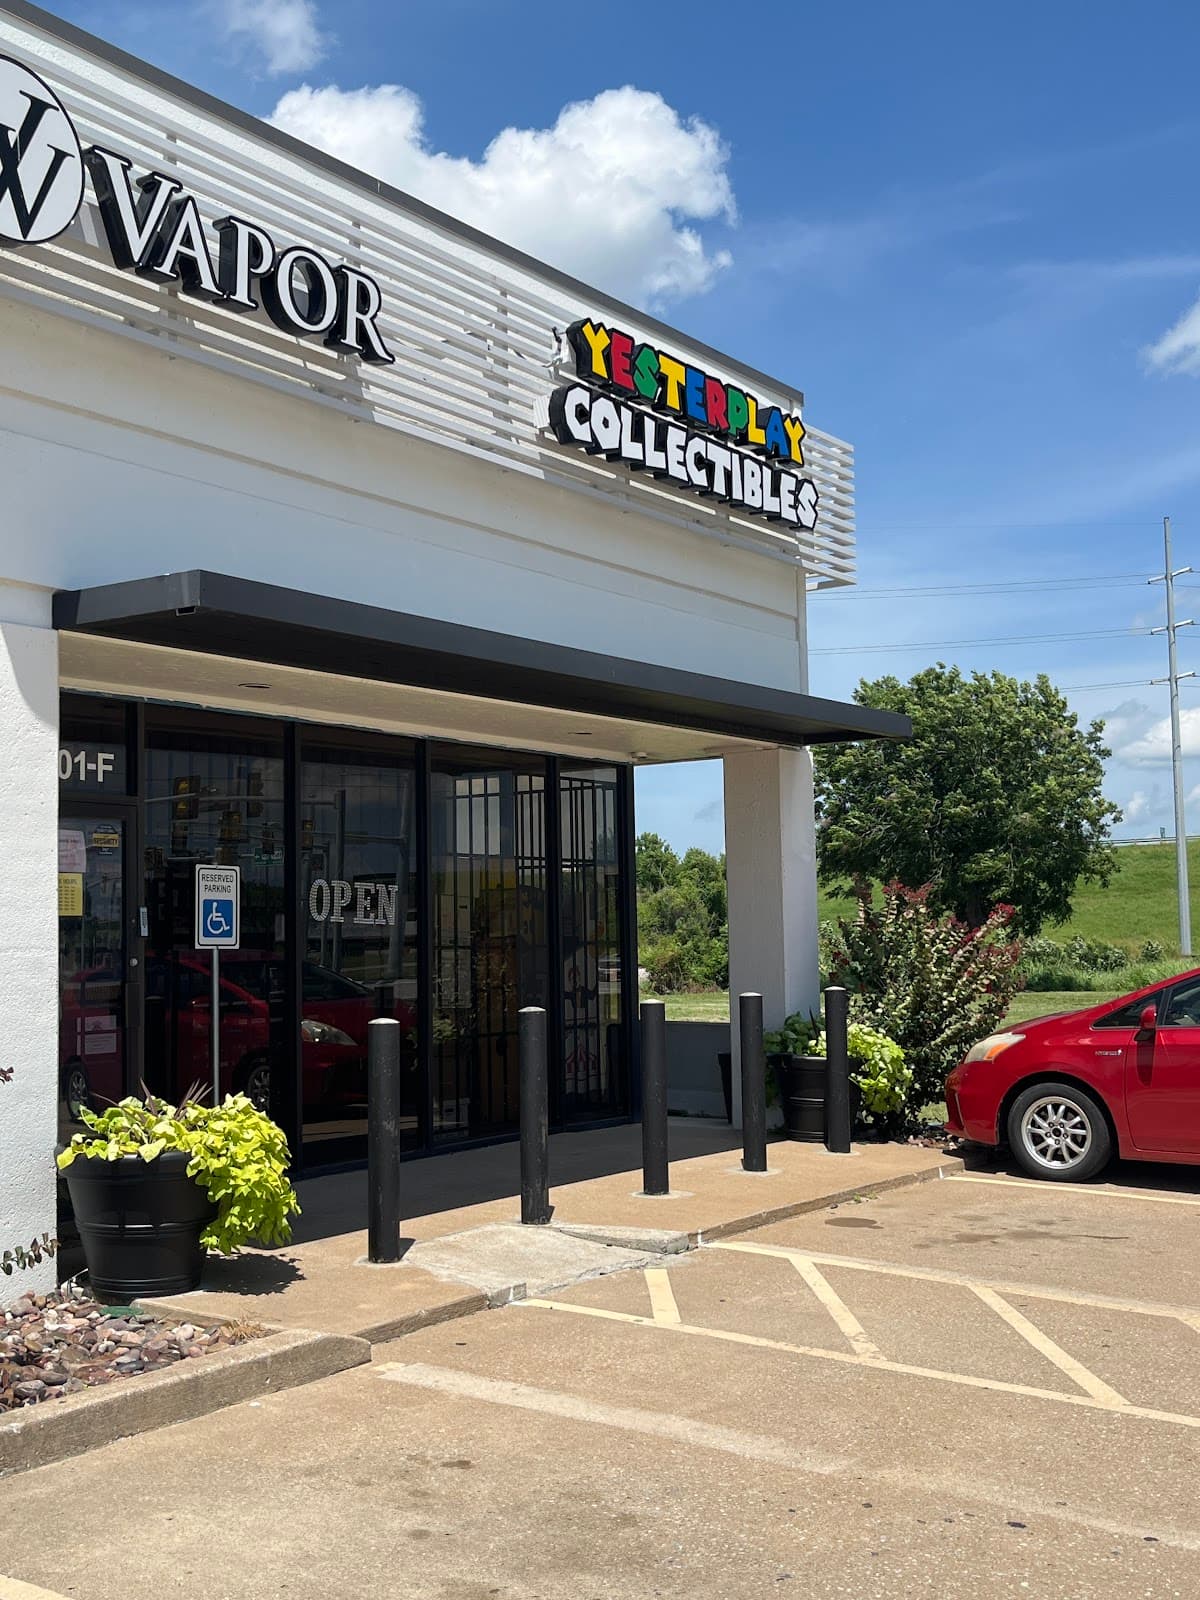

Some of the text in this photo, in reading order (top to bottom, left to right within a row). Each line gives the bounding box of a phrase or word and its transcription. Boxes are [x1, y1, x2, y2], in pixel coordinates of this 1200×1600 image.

[89, 146, 394, 363] VAPOR
[577, 319, 805, 466] YESTERPLAY
[560, 384, 818, 530] COLLECTIBLES
[201, 873, 234, 883] RESERVED
[204, 884, 232, 894] PARKING
[309, 878, 399, 925] OPEN
